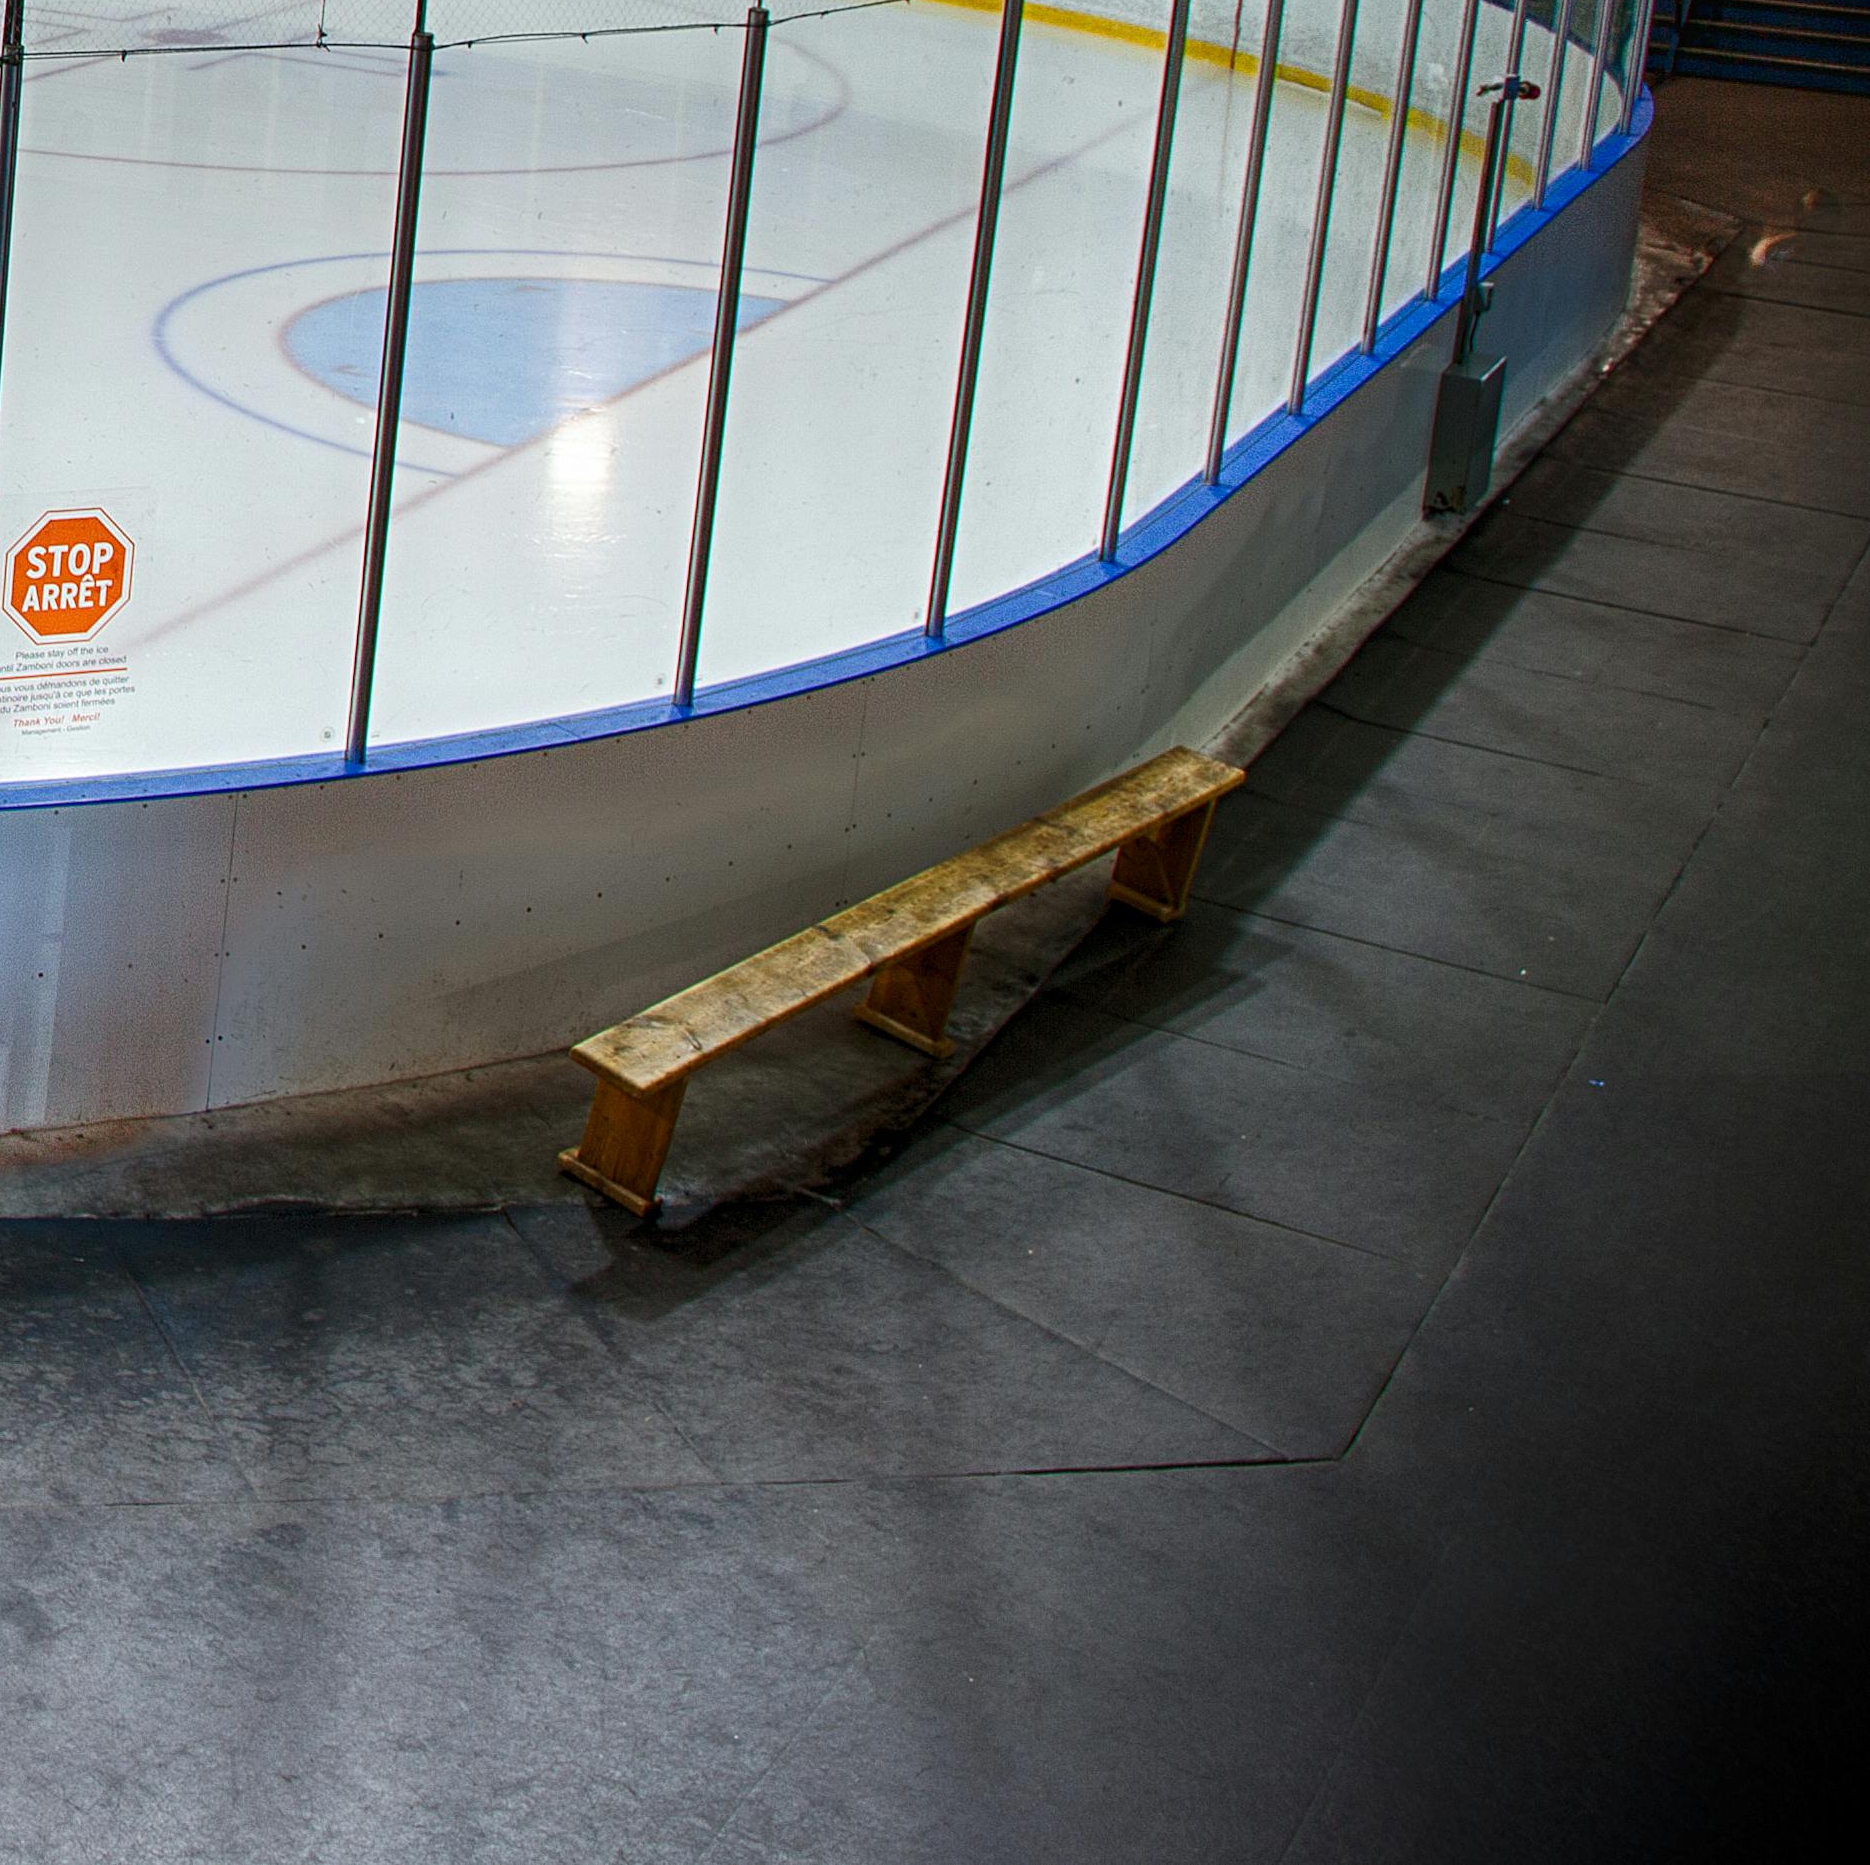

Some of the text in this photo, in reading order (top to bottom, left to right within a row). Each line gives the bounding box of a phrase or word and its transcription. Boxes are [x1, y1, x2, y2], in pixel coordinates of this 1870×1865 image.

[25, 541, 115, 580] STOP
[21, 574, 113, 613] ARRÊT
[15, 645, 109, 661] Please stay off the ice
[16, 660, 54, 672] Zamboni
[55, 659, 80, 669] doors
[82, 658, 97, 666] are
[98, 655, 128, 665] closed
[14, 684, 35, 693] vous
[89, 676, 100, 686] de
[102, 675, 130, 687] quitter
[30, 689, 61, 703] jusqu'à
[63, 690, 74, 699] ce
[76, 688, 93, 700] que
[94, 686, 107, 696] les
[108, 684, 136, 697] portes
[0, 696, 116, 714] du Zamboni soient fermées
[13, 712, 101, 728] Thank You! Merci!
[21, 726, 62, 737] Management
